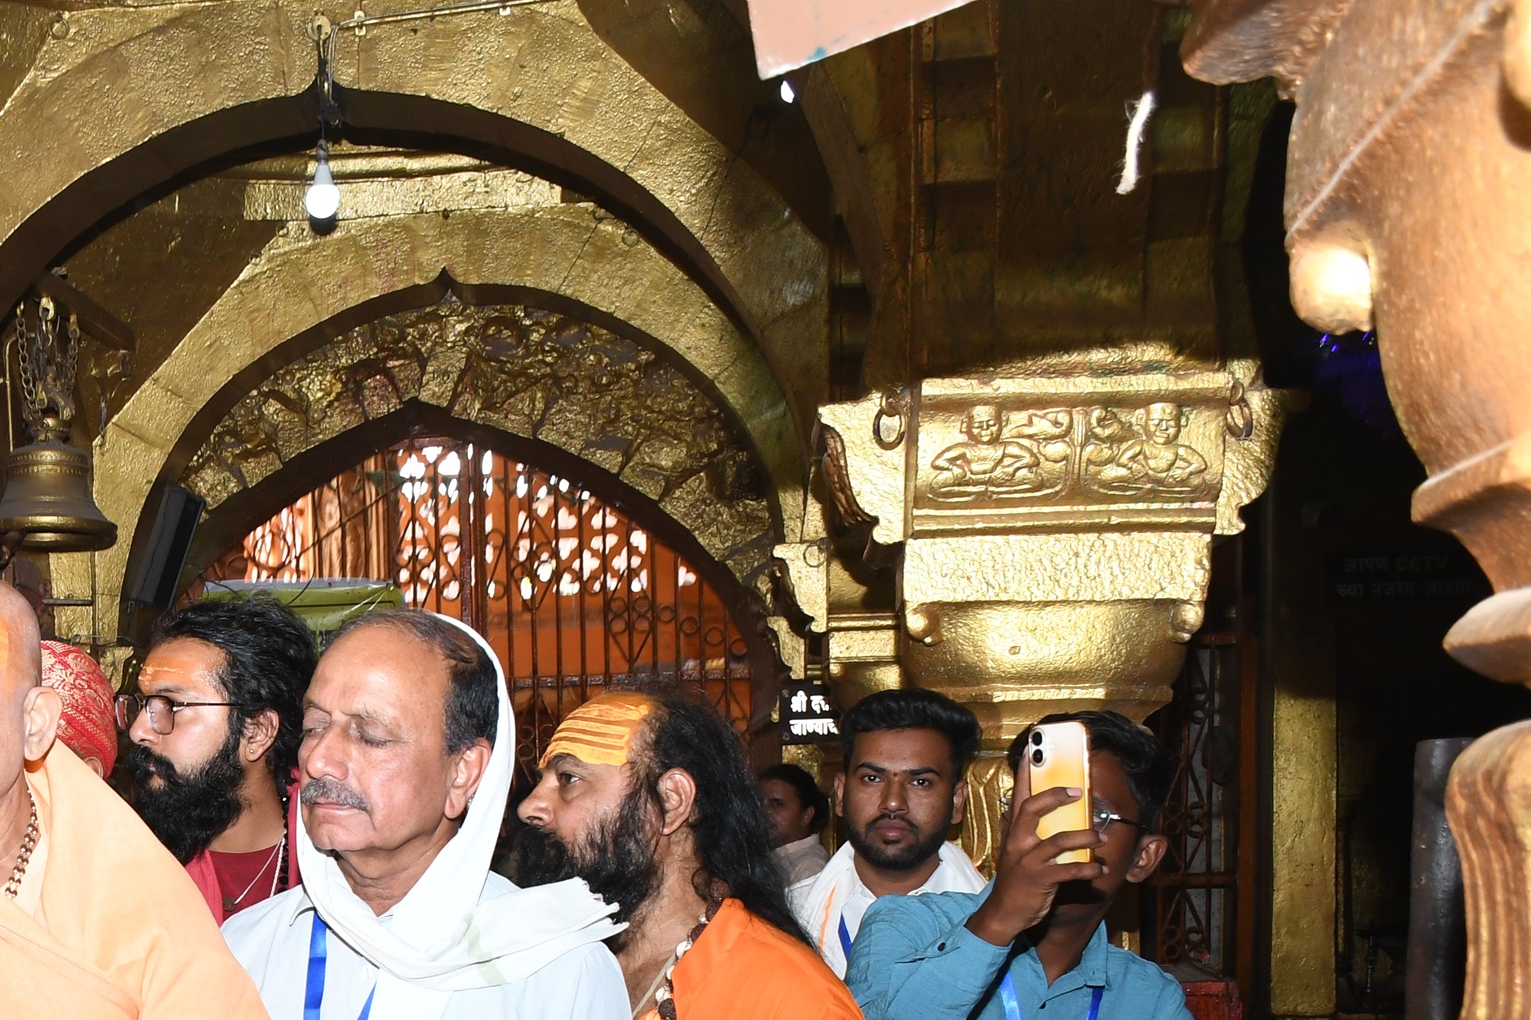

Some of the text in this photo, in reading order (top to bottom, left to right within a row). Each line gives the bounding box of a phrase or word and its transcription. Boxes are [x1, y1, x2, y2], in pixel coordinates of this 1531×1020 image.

[1343, 554, 1449, 573] आपण CCTV
[790, 690, 808, 713] श्री
